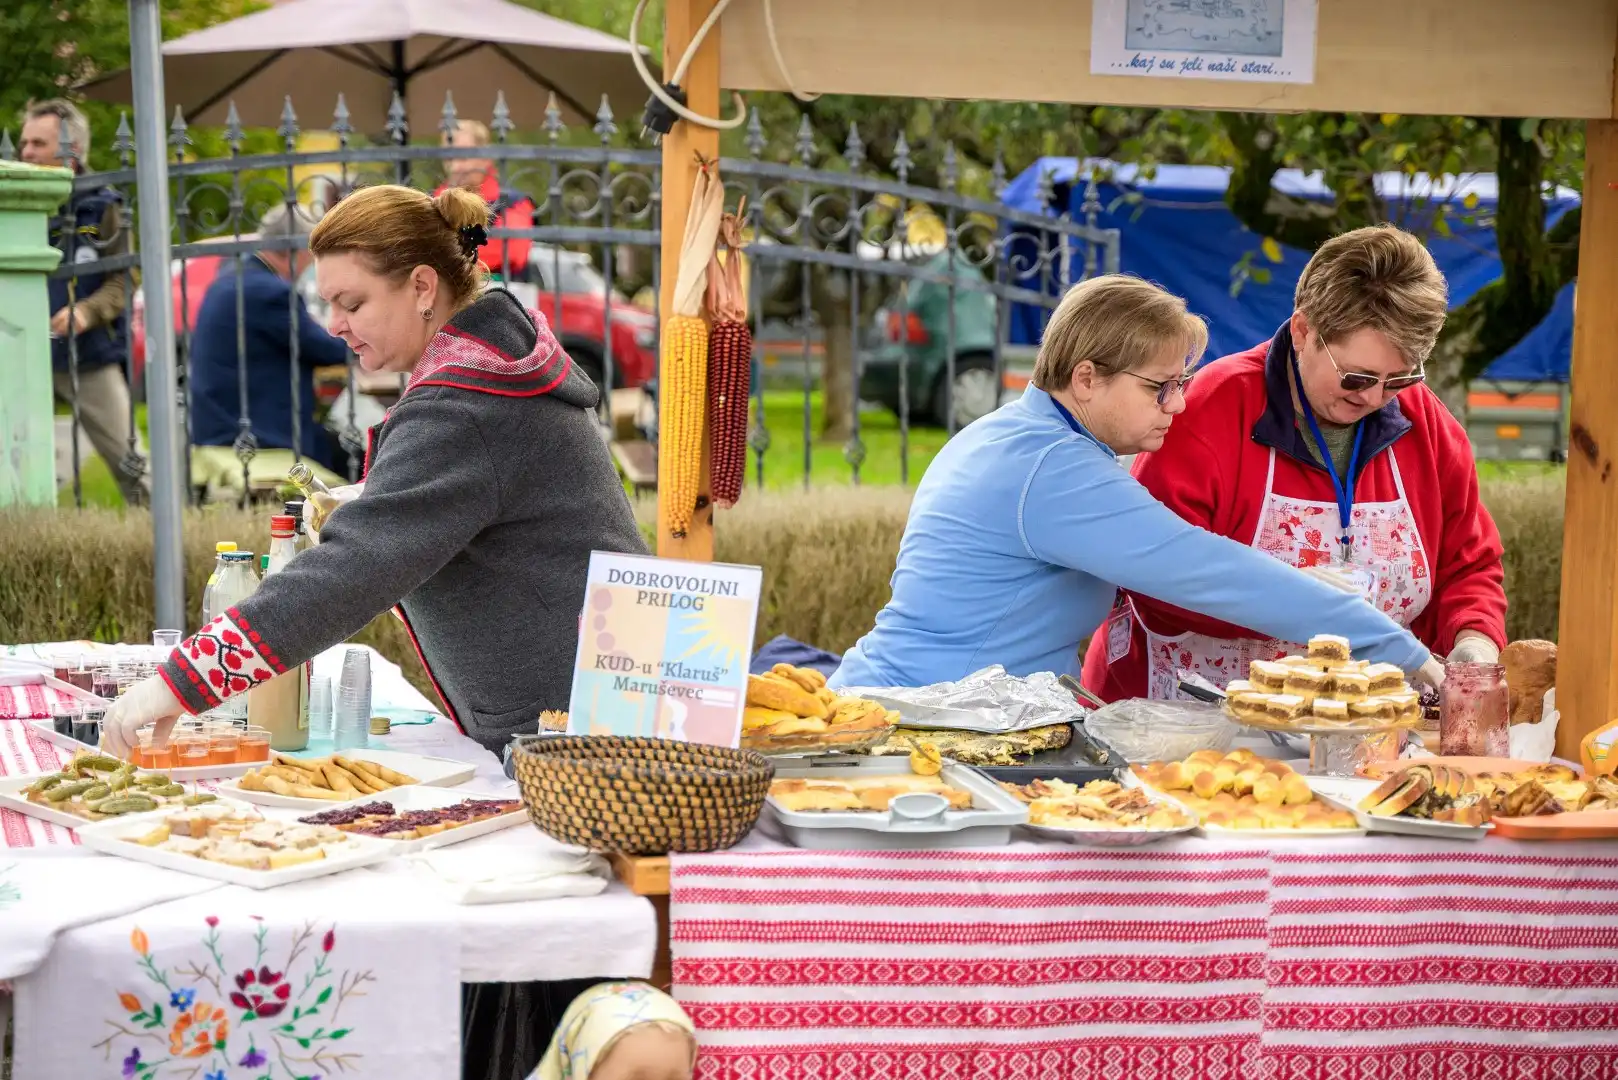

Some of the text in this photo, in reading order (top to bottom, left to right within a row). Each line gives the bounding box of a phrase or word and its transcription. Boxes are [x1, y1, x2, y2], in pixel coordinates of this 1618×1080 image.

[1160, 59, 1175, 70] su
[1179, 56, 1203, 74] jeli
[1207, 58, 1237, 72] naši
[608, 568, 739, 597] DOBROVOLJNI
[636, 590, 704, 611] PRILOG
[595, 654, 652, 676] KUD-u
[613, 676, 704, 700] Maruševec
